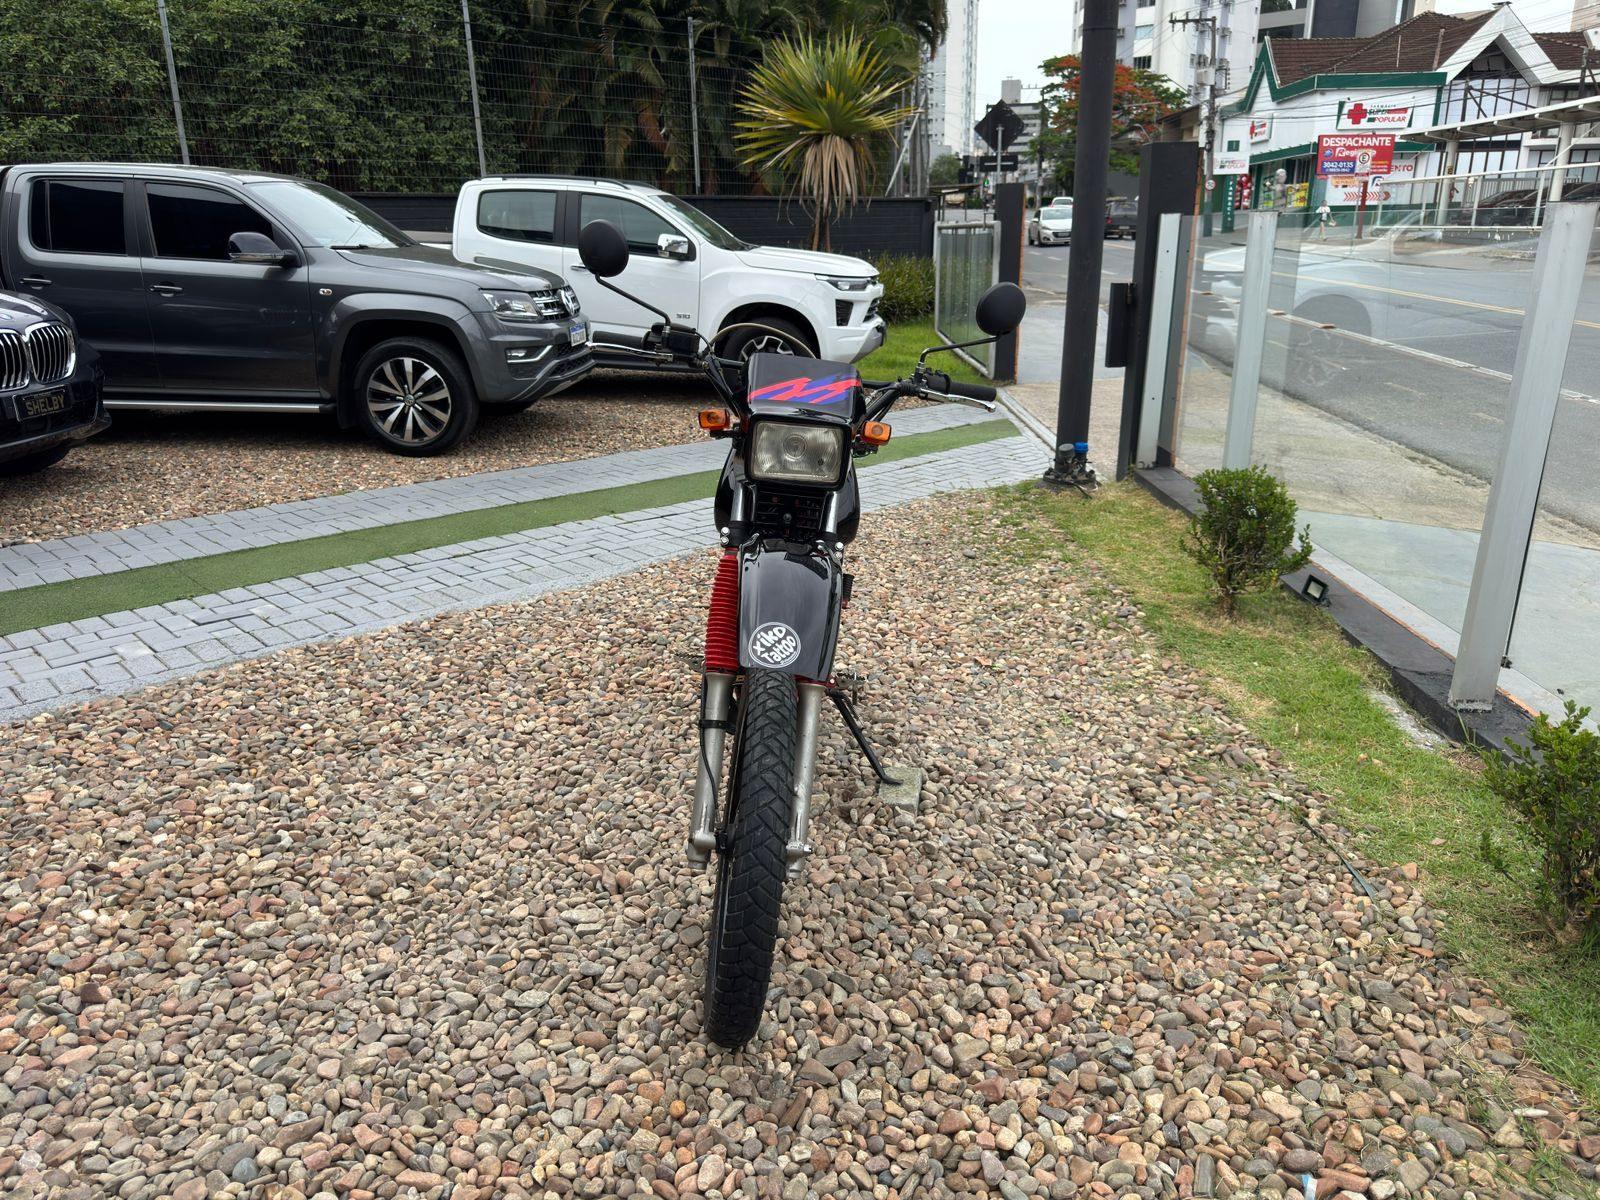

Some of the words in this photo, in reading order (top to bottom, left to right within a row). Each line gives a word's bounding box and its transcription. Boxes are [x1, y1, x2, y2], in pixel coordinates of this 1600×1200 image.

[1322, 137, 1392, 147] DESPACHANTE
[25, 394, 64, 416] SHELBY
[761, 635, 796, 664] Tattoo
